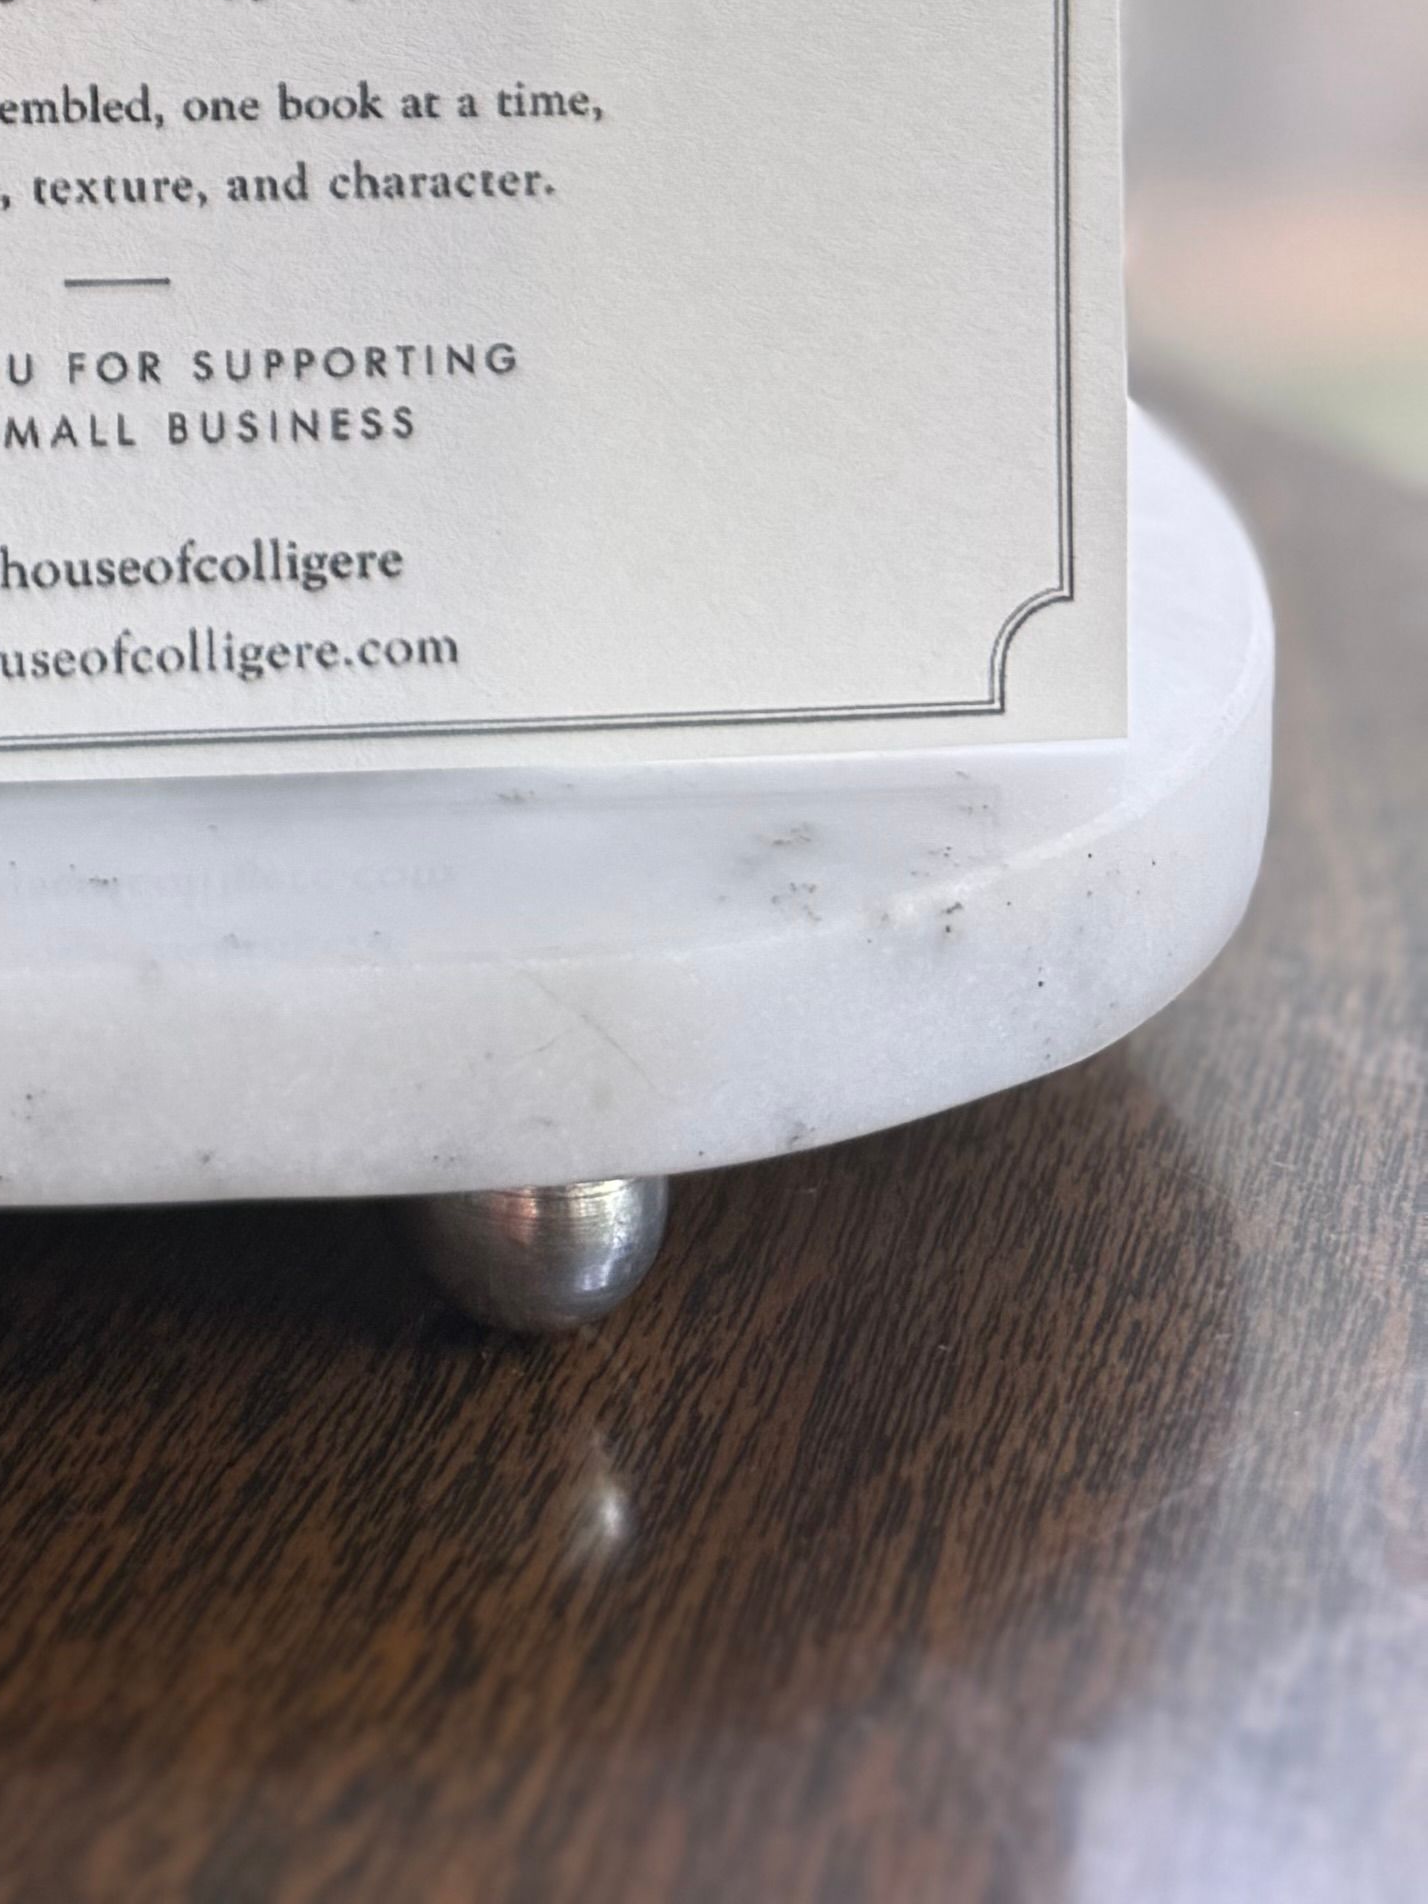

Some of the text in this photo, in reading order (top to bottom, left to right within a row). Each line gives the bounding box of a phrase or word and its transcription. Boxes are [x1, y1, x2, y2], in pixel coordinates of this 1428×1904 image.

[182, 95, 263, 124] one
[277, 79, 386, 123] book
[400, 91, 443, 121] at
[456, 92, 482, 120] a
[496, 80, 605, 124] time,
[32, 175, 209, 212] texture,
[226, 160, 311, 203] and
[328, 158, 557, 202] character.
[67, 350, 163, 387] FOR
[192, 342, 519, 385] SUPPORTING
[167, 405, 416, 448] BUSINESS
